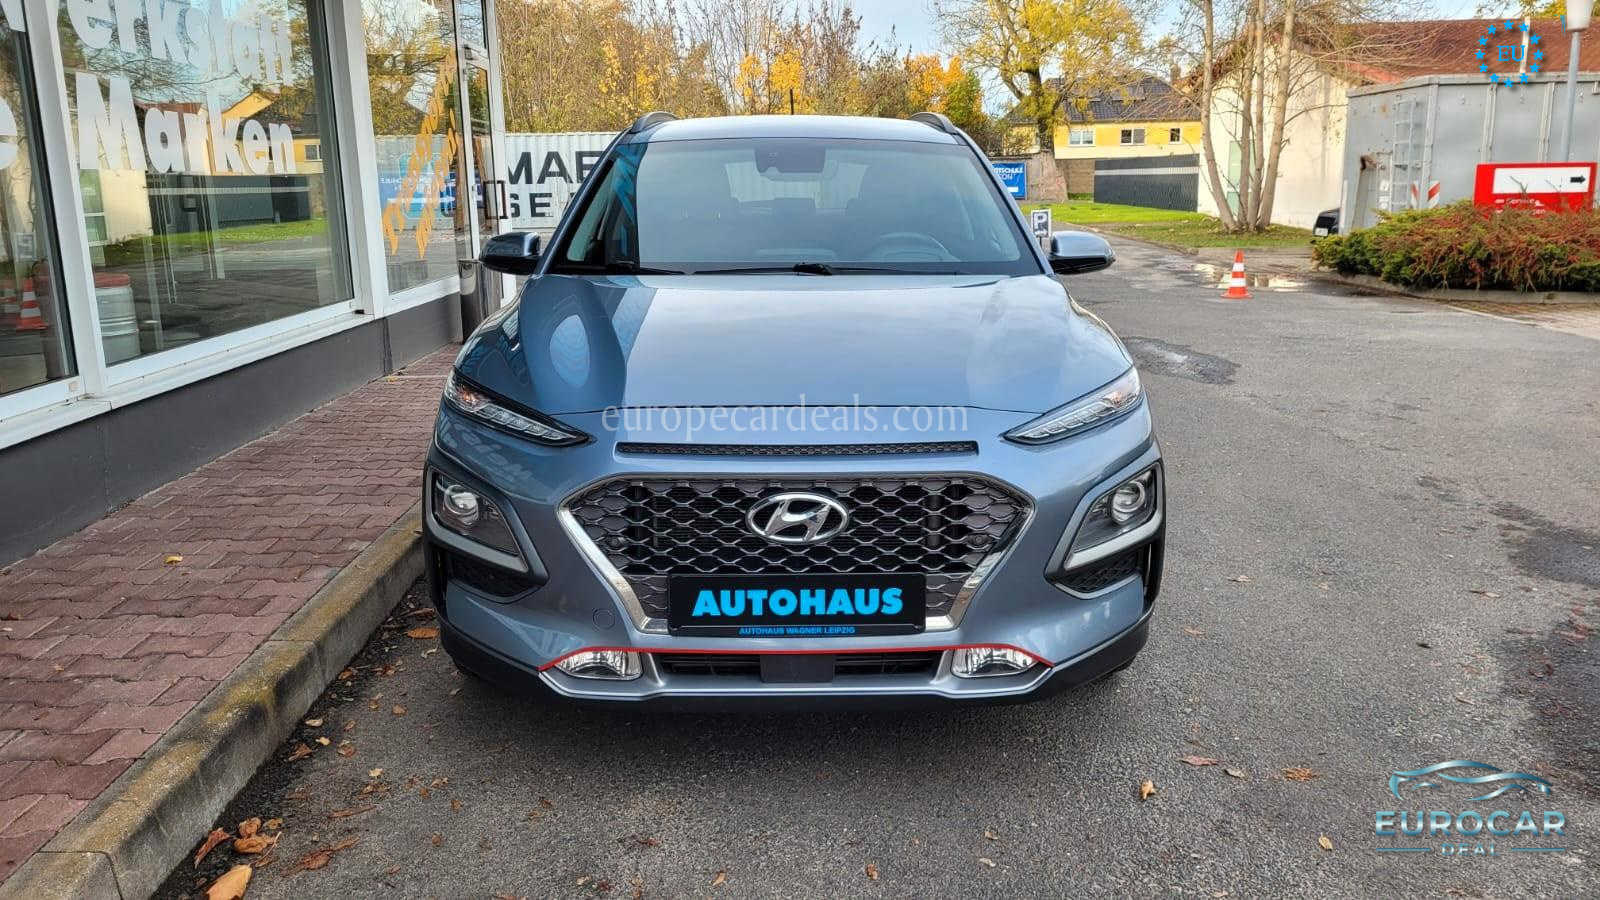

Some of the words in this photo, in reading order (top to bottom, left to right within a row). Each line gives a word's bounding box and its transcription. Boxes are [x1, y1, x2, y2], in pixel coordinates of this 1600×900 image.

[0, 0, 292, 87] erkstatt
[76, 72, 297, 175] Marken
[1034, 213, 1048, 229] P
[692, 587, 904, 617] AUTOHAUS
[739, 627, 784, 635] AUTOHAUS
[786, 627, 822, 635] WAGNER
[824, 626, 855, 635] LEIPZIG
